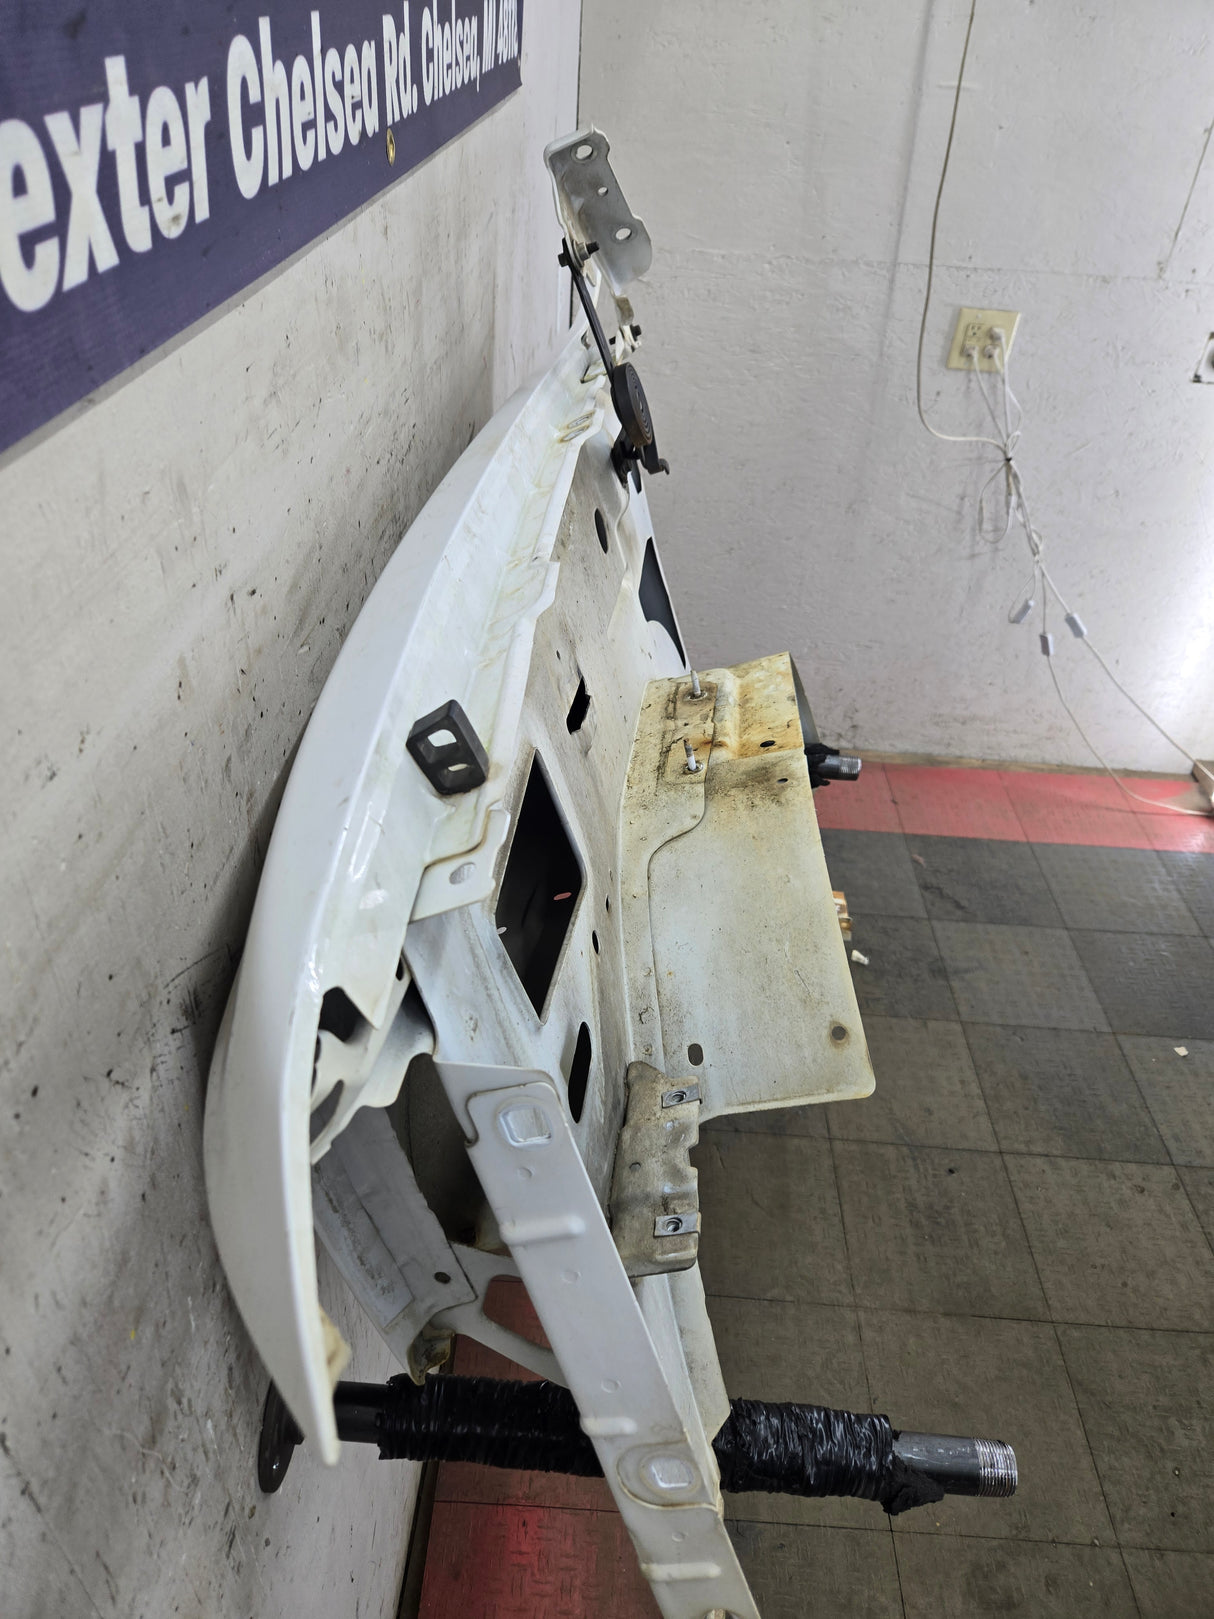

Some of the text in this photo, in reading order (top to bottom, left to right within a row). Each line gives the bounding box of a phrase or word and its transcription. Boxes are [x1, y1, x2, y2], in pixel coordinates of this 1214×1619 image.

[0, 55, 212, 312] exter
[227, 10, 379, 199] Chelsea
[382, 1, 418, 127] Rd.
[421, 0, 480, 106] Chelsea,
[482, 0, 496, 74] MI
